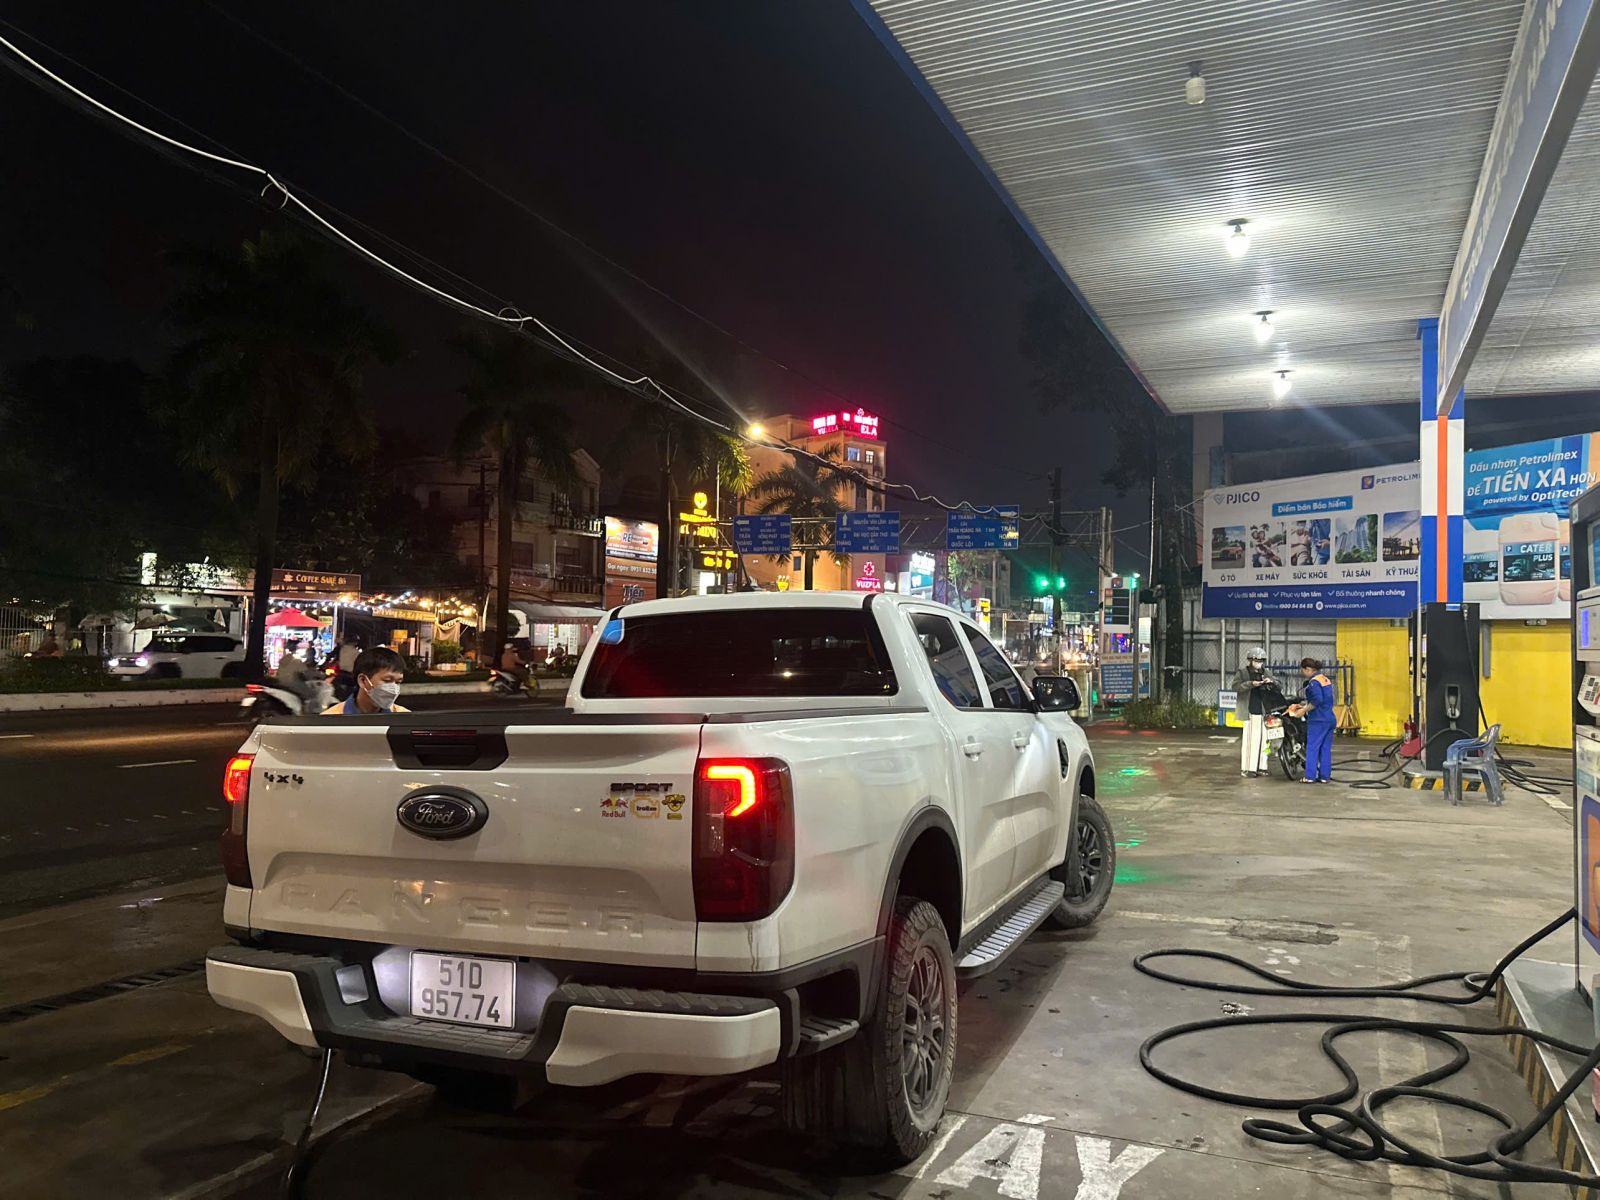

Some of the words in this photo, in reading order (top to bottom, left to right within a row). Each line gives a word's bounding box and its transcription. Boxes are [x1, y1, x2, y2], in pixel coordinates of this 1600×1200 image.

[1519, 450, 1578, 466] Petrolimex
[1376, 474, 1420, 484] PETROLIM
[1483, 467, 1530, 494] TIẾN
[1536, 467, 1566, 489] XA
[1226, 491, 1260, 505] PJICO
[1483, 494, 1517, 505] powered
[1519, 494, 1529, 502] by
[1520, 544, 1552, 553] CATER
[1533, 554, 1553, 562] PLUS
[1265, 572, 1280, 581] MÁY
[264, 772, 304, 784] 4x4
[610, 783, 673, 792] SPORT
[414, 802, 456, 824] Ford
[281, 882, 645, 938] RANGER
[440, 959, 482, 989] 51D
[422, 988, 500, 1023] 957.74
